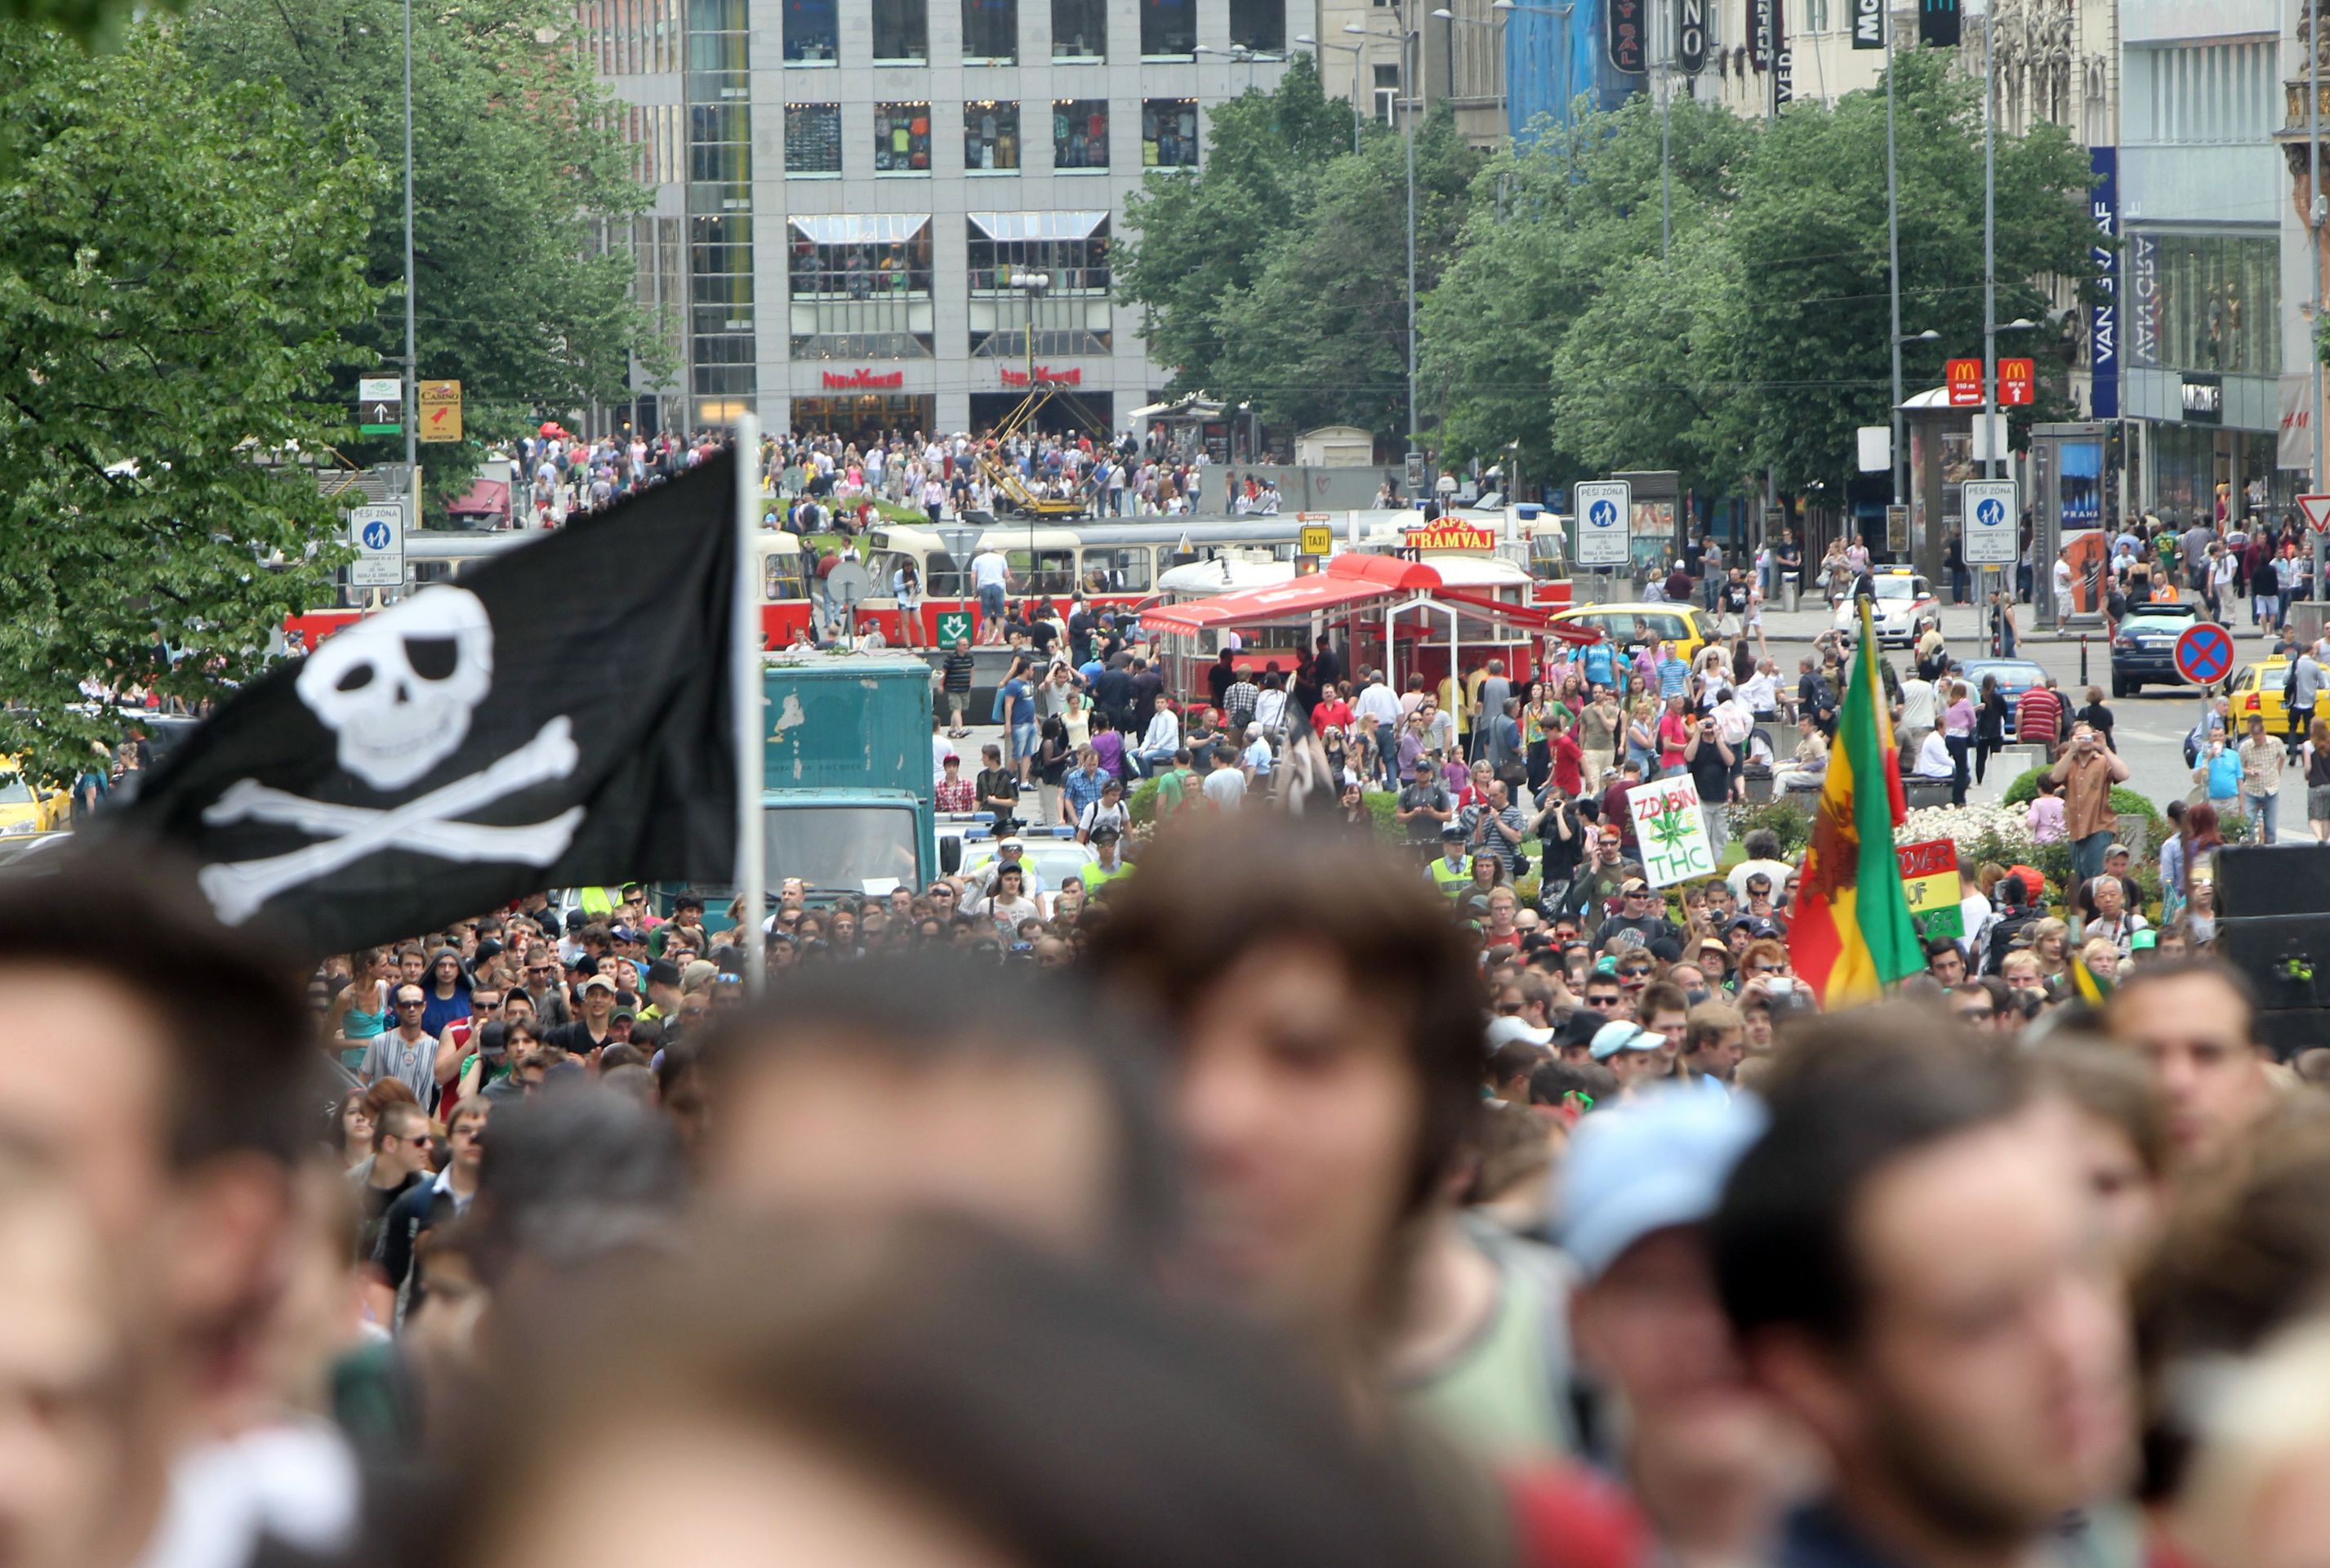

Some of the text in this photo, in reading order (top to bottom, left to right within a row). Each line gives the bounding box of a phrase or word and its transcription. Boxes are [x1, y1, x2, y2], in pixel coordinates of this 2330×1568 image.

[2096, 305, 2114, 364] VAN
[421, 391, 458, 400] CASINO
[2062, 510, 2099, 518] PRAHA
[1308, 535, 1325, 546] TAXI
[1407, 532, 1492, 549] TRAMVAJ
[1648, 846, 1708, 881] THC
[1908, 882, 1927, 905] OF
